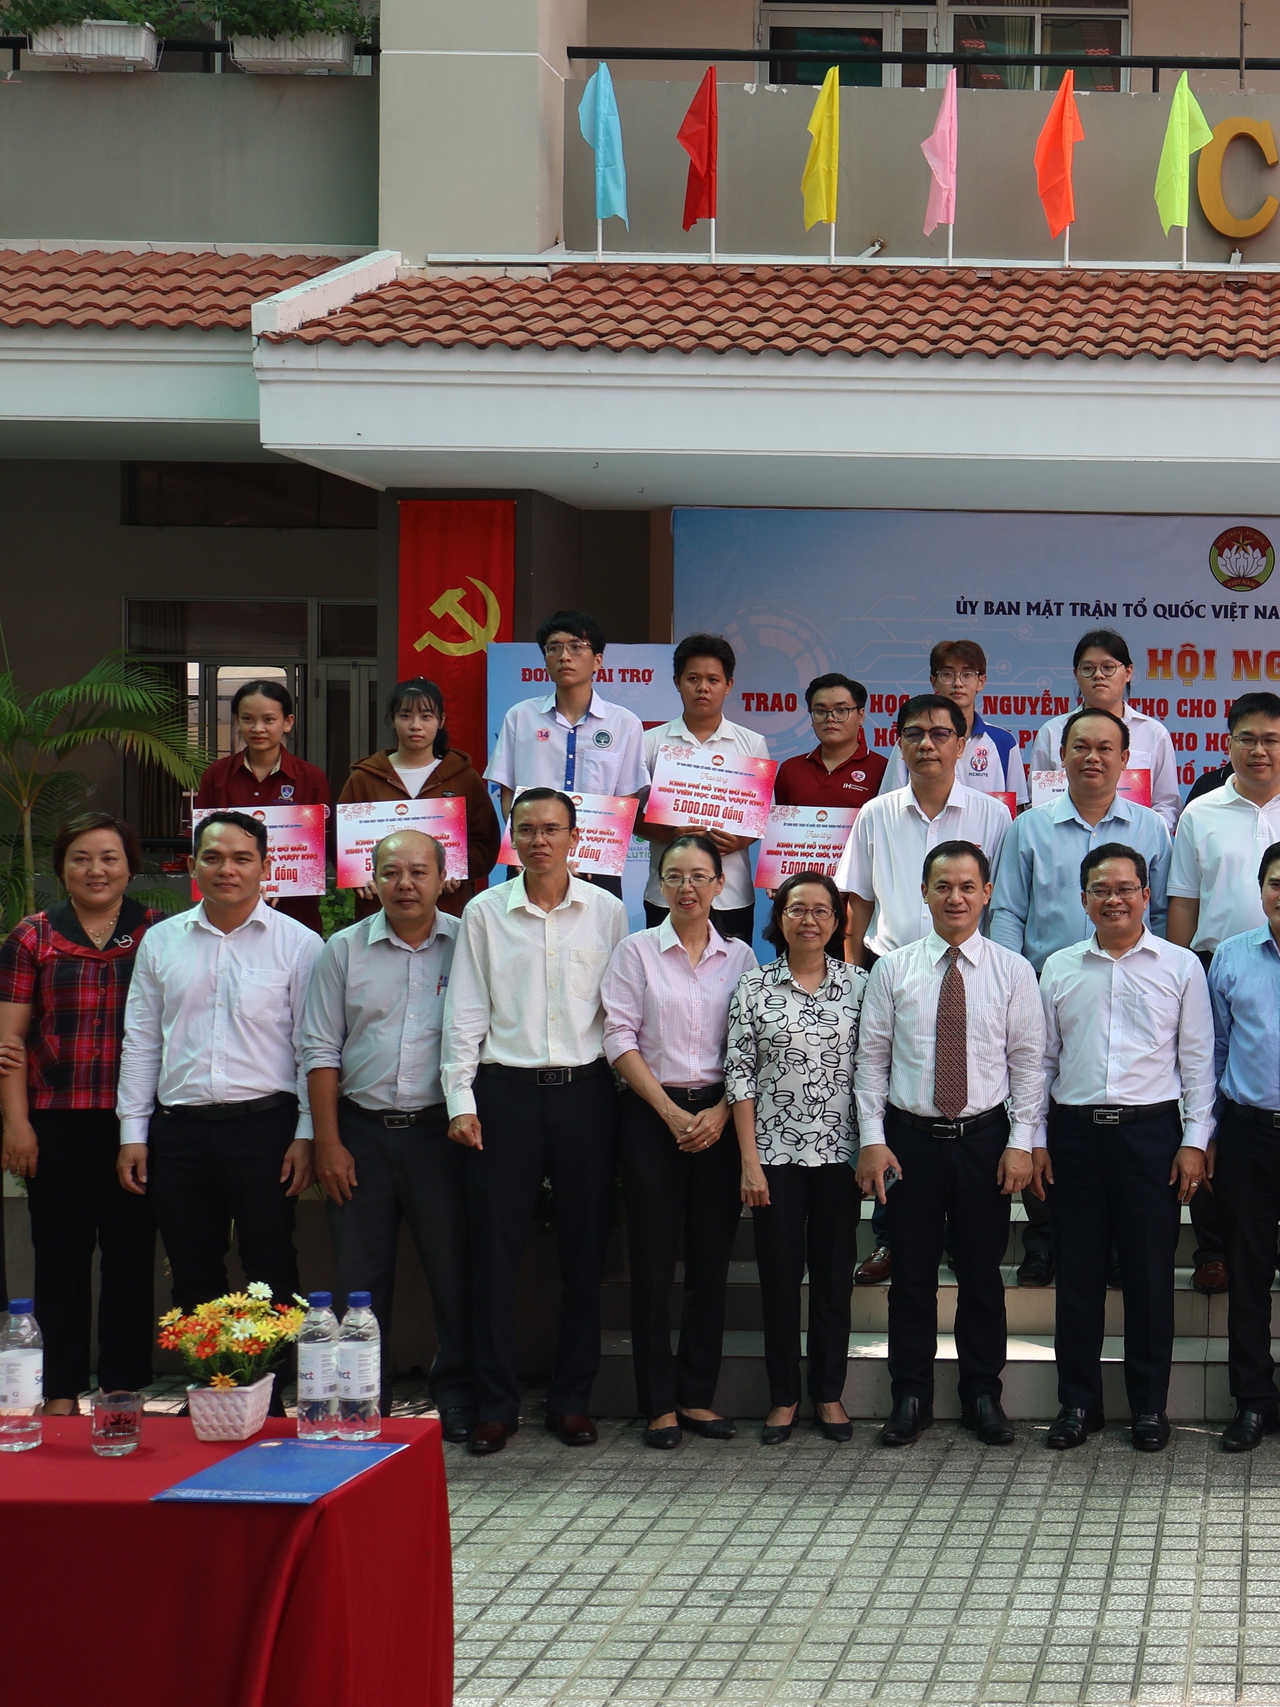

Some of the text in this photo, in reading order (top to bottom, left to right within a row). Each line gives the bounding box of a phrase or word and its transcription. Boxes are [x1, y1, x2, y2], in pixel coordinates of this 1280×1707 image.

[1198, 116, 1280, 239] C
[956, 596, 979, 615] ỦY
[984, 600, 1021, 616] BAN
[1026, 600, 1064, 620] MẶT
[1069, 601, 1117, 621] TRẬN
[1122, 597, 1148, 618] TỔ
[1153, 600, 1207, 620] QUỐC
[1211, 603, 1249, 623] VIỆT
[1146, 642, 1217, 687] HỘI
[618, 668, 654, 686] TRỢ
[742, 692, 797, 713] TRAO
[983, 690, 1070, 715] NGUYỄN
[1177, 698, 1217, 718] CHO
[538, 730, 549, 738] 34
[977, 748, 987, 756] 30
[852, 772, 863, 780] 32
[669, 780, 687, 788] KINH
[688, 781, 701, 790] PHÍ
[701, 782, 712, 791] HỖ
[713, 786, 728, 794] TRỢ
[658, 786, 675, 794] SINH
[676, 788, 692, 797] VIÊN
[694, 791, 709, 799] HỌC
[729, 796, 748, 805] VƯỢT
[749, 798, 765, 807] KHÓ
[673, 799, 744, 823] 5.000.000 đồng
[579, 845, 601, 861] đồng
[784, 849, 799, 857] VIÊN
[800, 851, 814, 859] HỌC
[794, 841, 806, 849] PHÍ
[807, 841, 817, 849] HỖ
[818, 843, 831, 851] TRỢ
[275, 865, 298, 882] đồng
